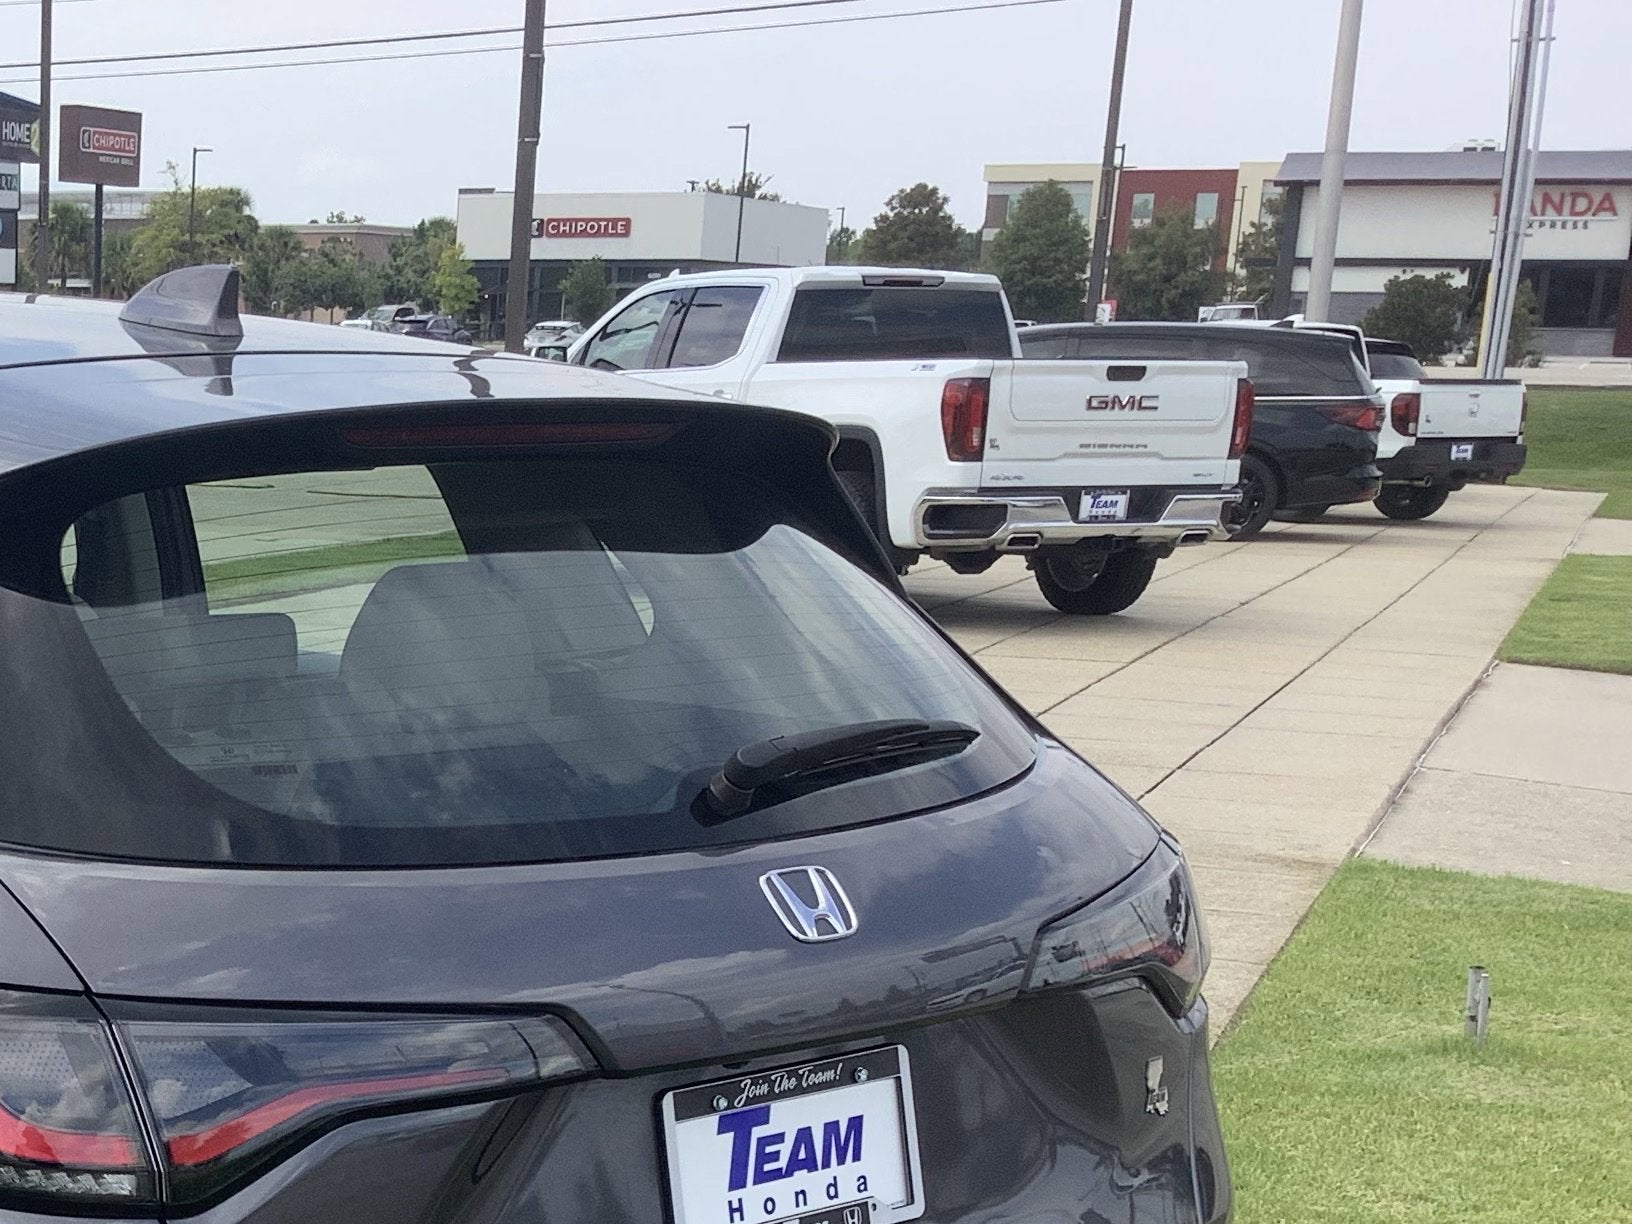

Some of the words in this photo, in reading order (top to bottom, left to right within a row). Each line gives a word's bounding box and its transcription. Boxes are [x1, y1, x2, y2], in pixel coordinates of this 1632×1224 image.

[2, 121, 30, 143] HOME
[93, 134, 135, 150] CHIPOTLE
[548, 221, 627, 234] CHIPOTLE
[1527, 220, 1589, 230] XPRESS
[1086, 395, 1159, 411] GMC
[1091, 494, 1118, 509] TEAM
[734, 1079, 770, 1107] Join
[771, 1071, 798, 1093] The
[799, 1063, 843, 1087] Team!
[717, 1104, 864, 1192] TEAM
[728, 1174, 868, 1224] Honda
